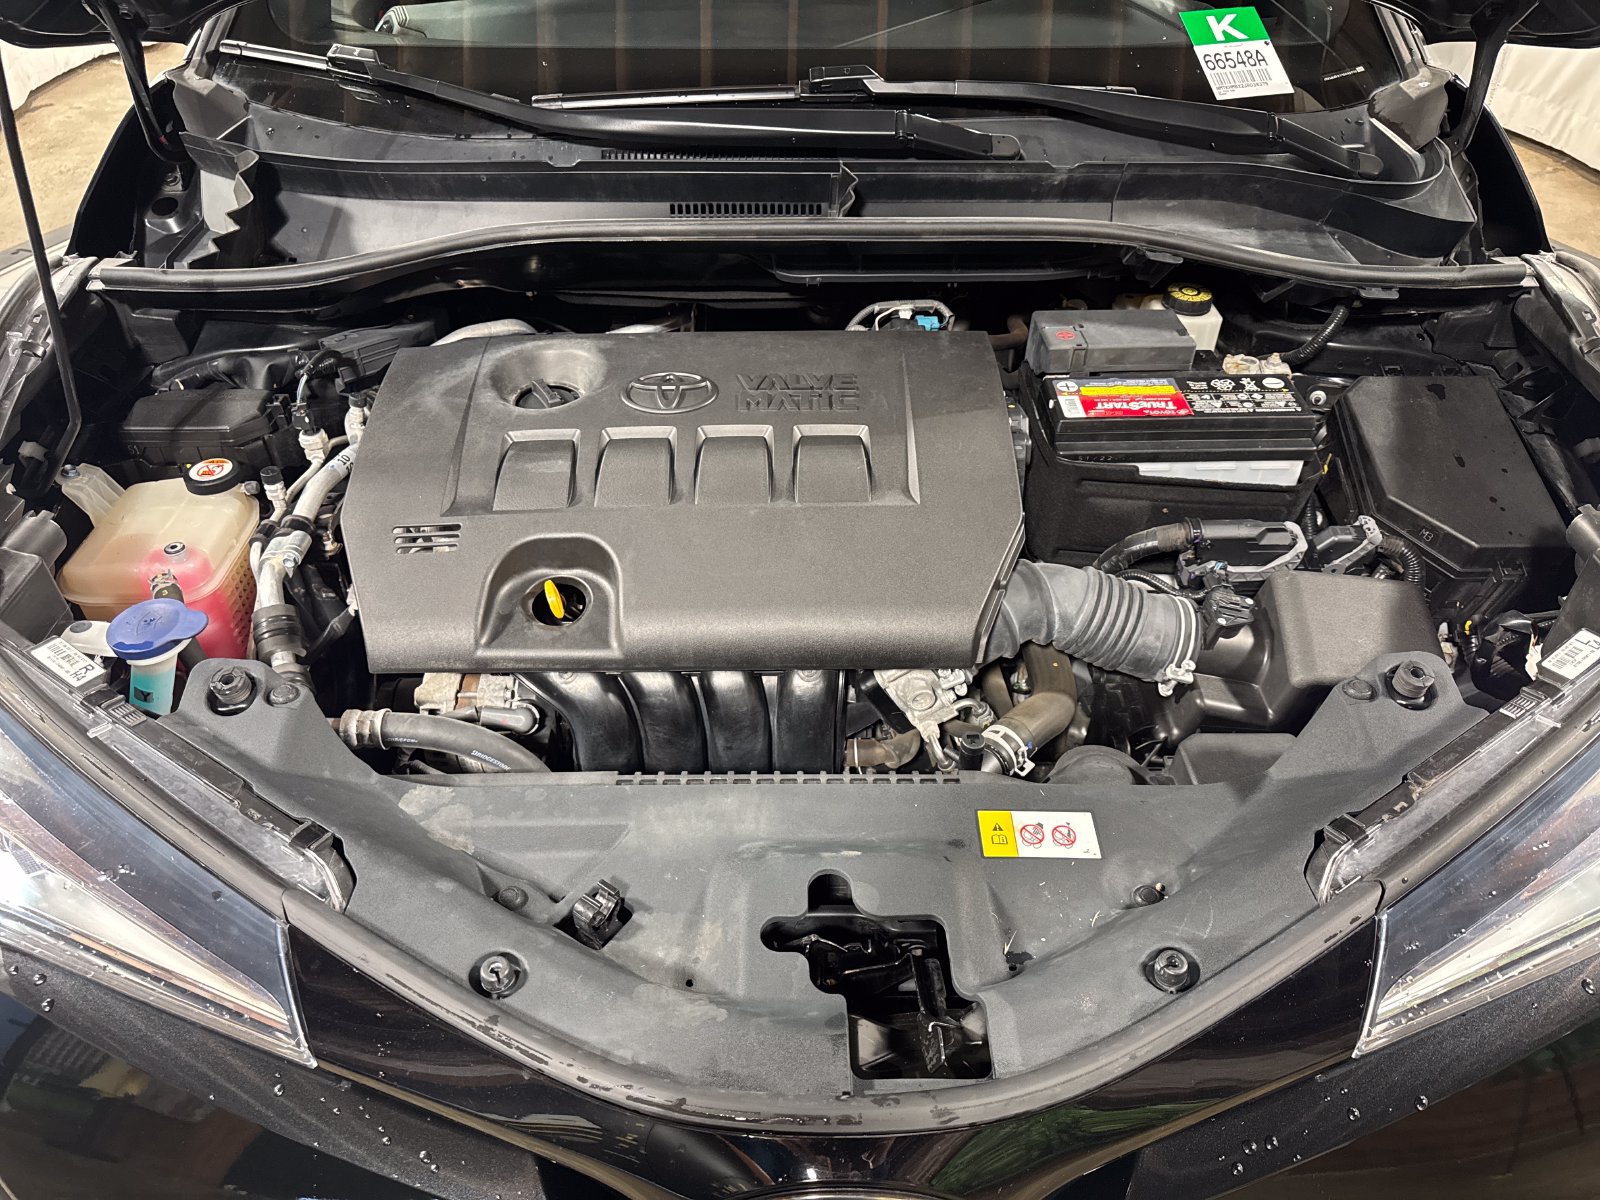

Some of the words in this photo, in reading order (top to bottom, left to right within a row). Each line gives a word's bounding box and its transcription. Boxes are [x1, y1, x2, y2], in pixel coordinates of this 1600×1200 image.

[1206, 13, 1249, 41] K
[1203, 50, 1268, 71] 66548A
[736, 373, 858, 390] VALVE
[736, 390, 859, 411] MATIC
